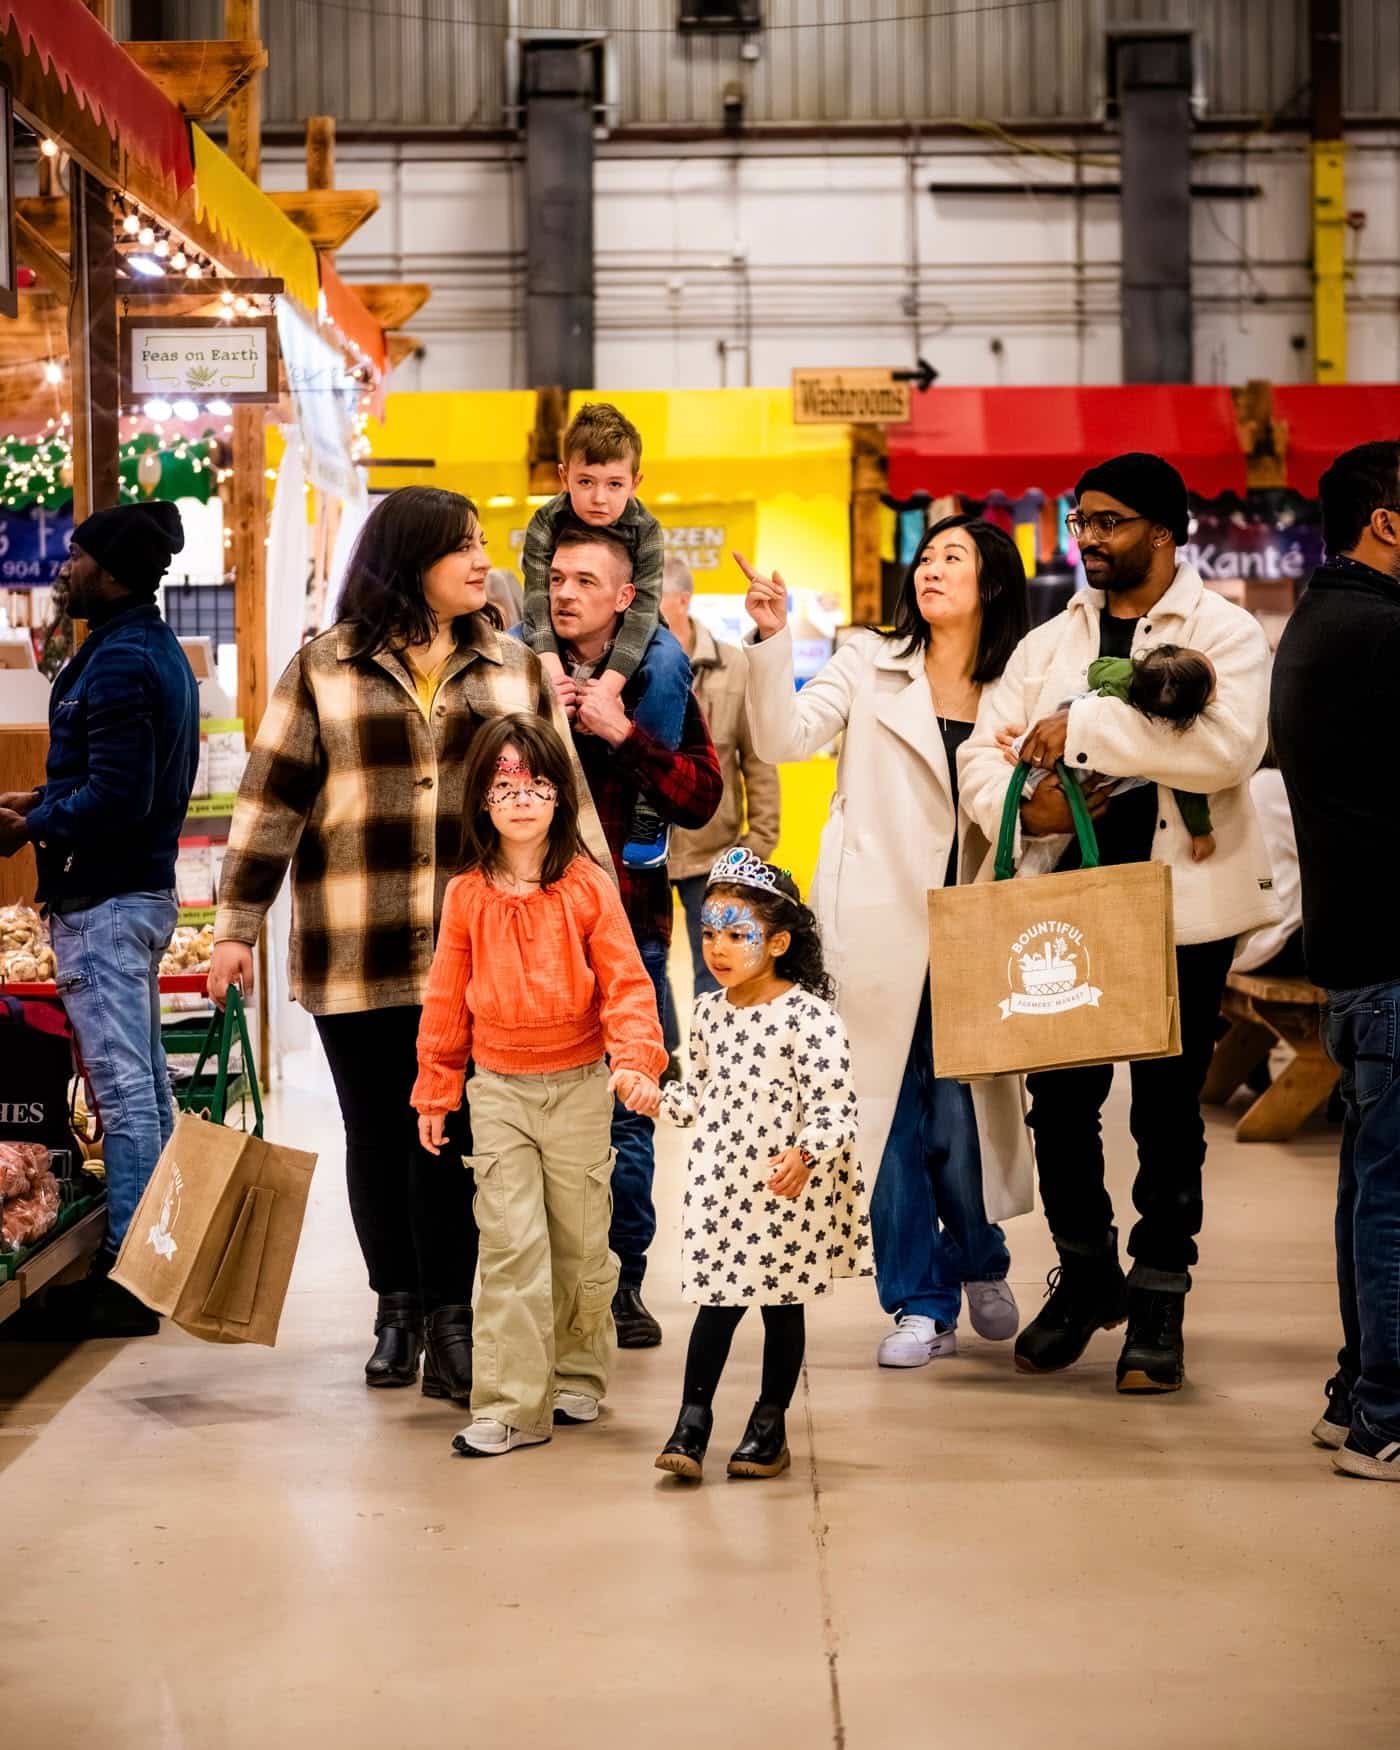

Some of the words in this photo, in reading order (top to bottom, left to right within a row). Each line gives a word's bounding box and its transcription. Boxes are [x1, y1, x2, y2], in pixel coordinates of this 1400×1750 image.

[142, 350, 179, 362] Peas
[185, 351, 205, 361] on
[211, 349, 259, 361] Earth
[800, 375, 903, 416] Washrooms
[2, 560, 41, 578] 904
[1011, 920, 1084, 954] BOUNTIFUL
